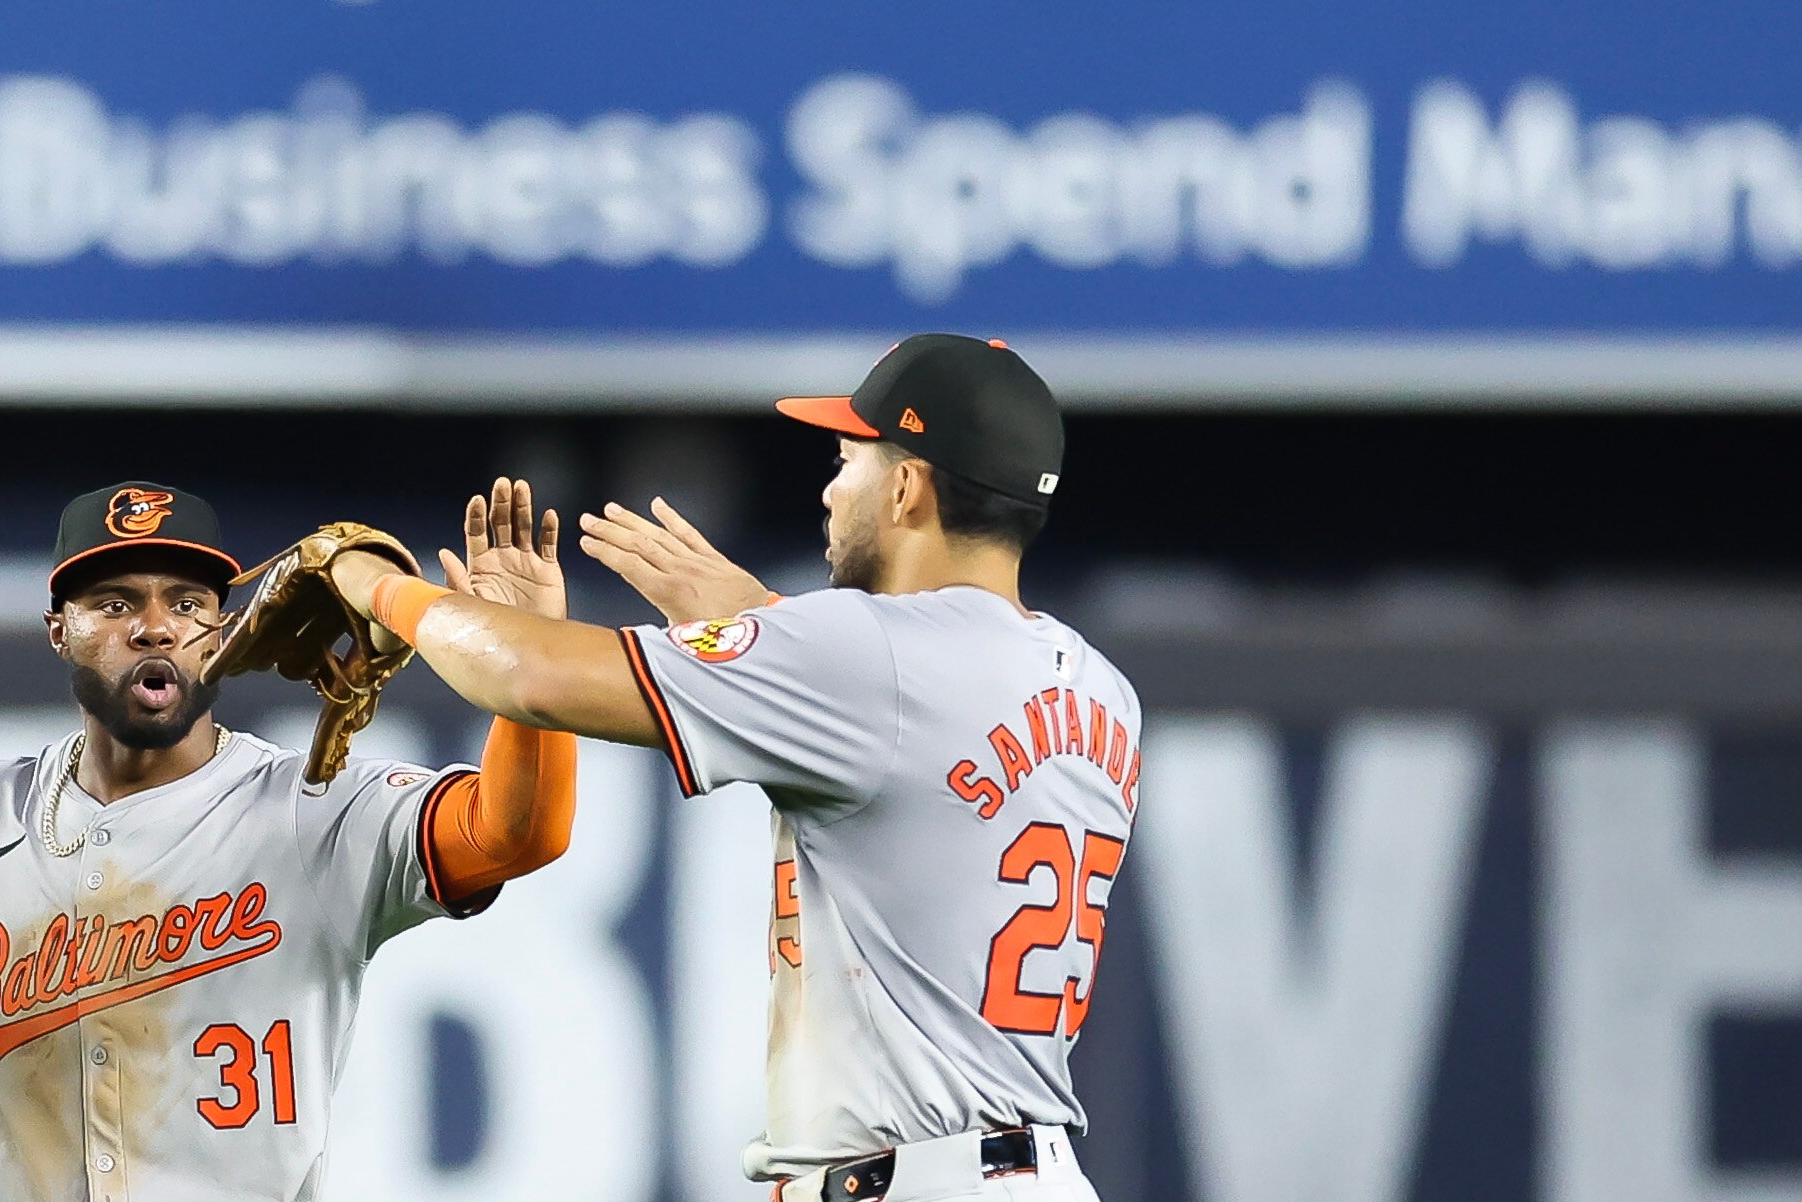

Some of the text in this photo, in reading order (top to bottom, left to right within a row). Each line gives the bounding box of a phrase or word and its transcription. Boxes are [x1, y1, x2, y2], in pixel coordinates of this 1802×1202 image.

[785, 70, 1374, 306] Spend
[1404, 74, 1802, 270] Man
[766, 858, 804, 978] 5
[980, 820, 1126, 1038] 25
[193, 1018, 297, 1130] 31
